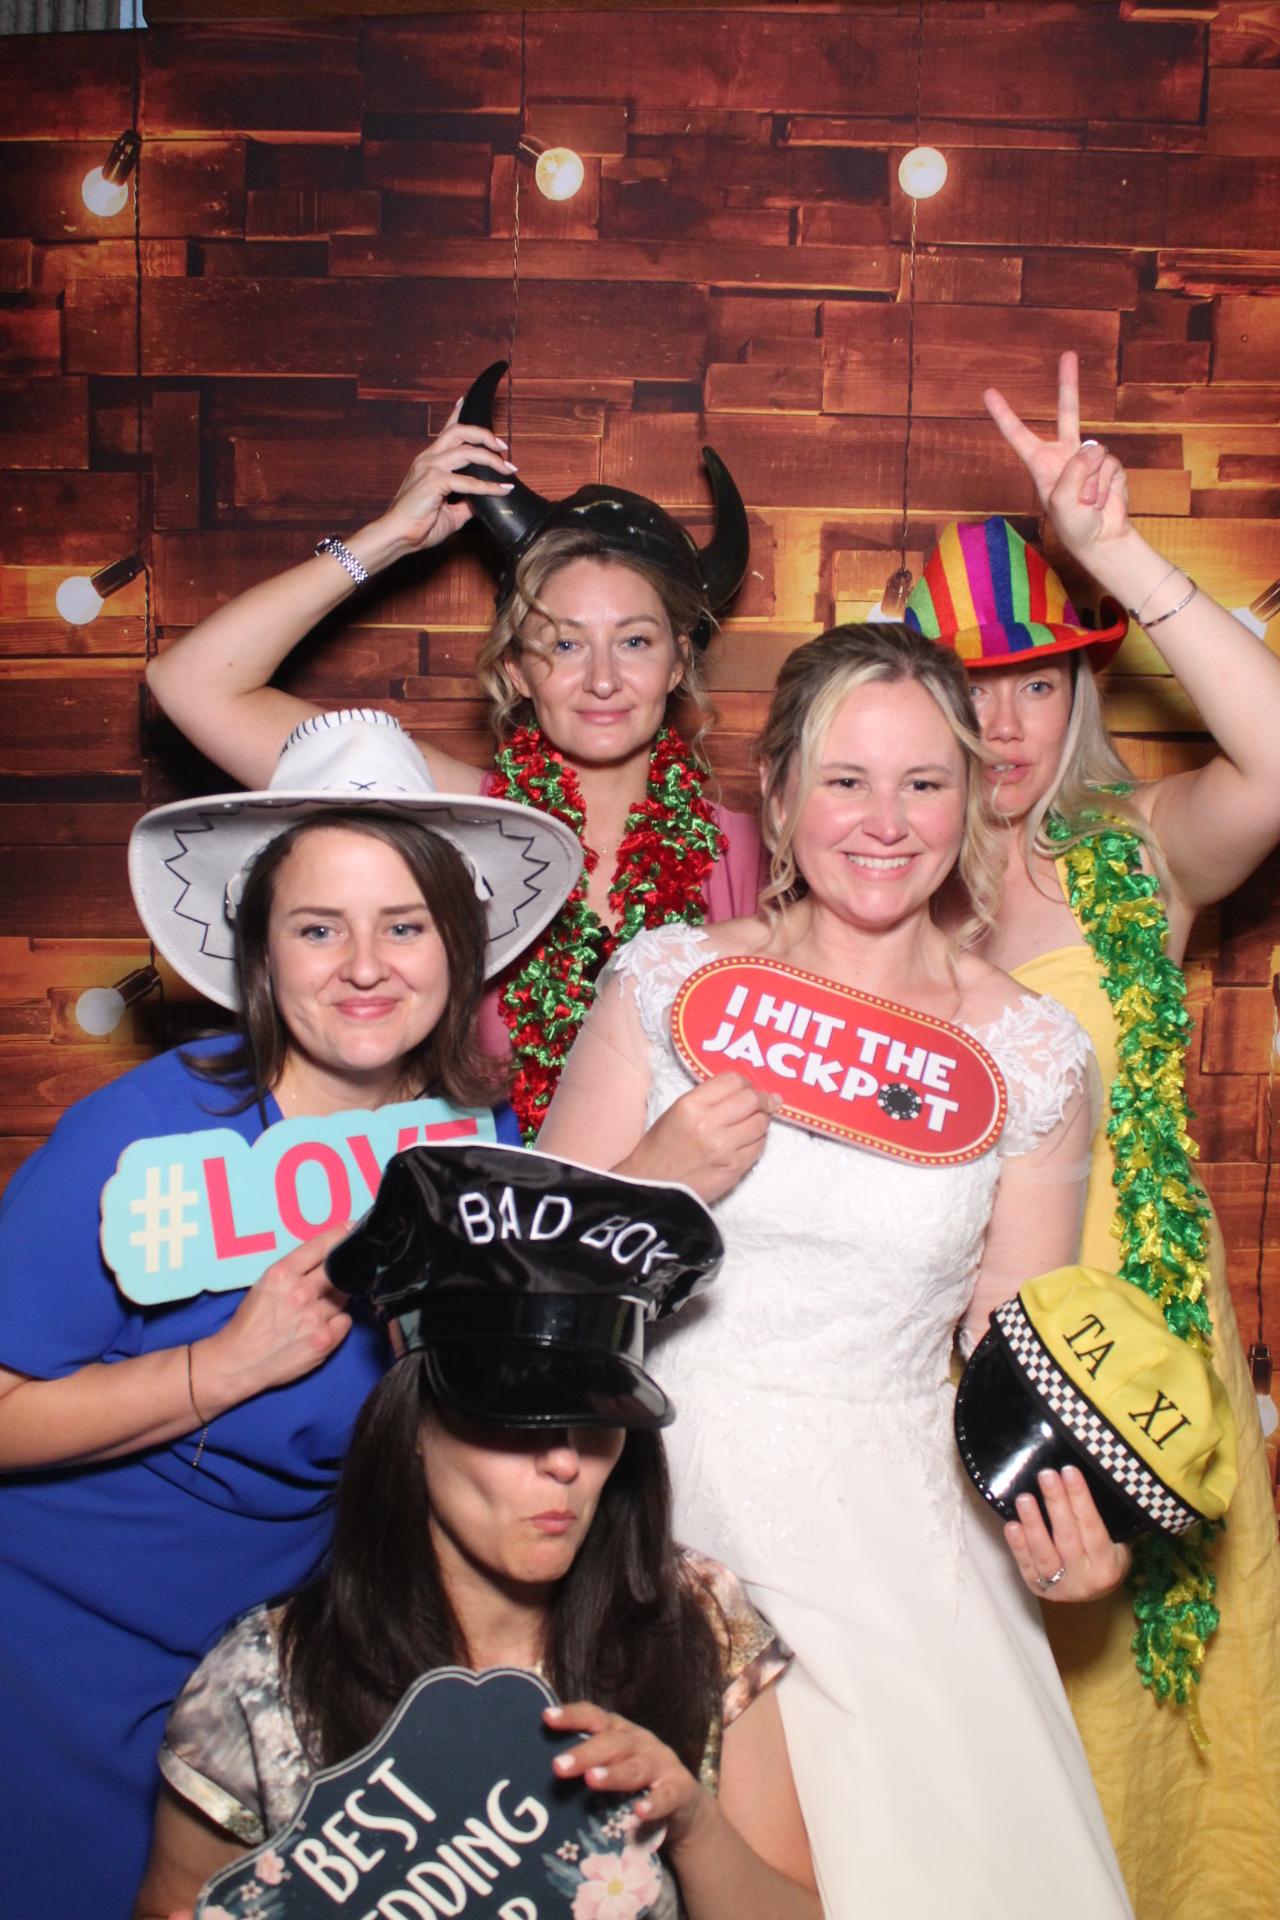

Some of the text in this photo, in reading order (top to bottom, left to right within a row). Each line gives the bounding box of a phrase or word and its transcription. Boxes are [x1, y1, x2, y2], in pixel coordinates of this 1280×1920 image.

[702, 1021, 959, 1133] JACKPOT
[724, 984, 957, 1093] I HIT THE
[129, 1117, 479, 1274] #LO
[458, 1186, 574, 1245] BAD
[291, 1757, 438, 1904] BEST
[358, 1778, 550, 1920] DDING
